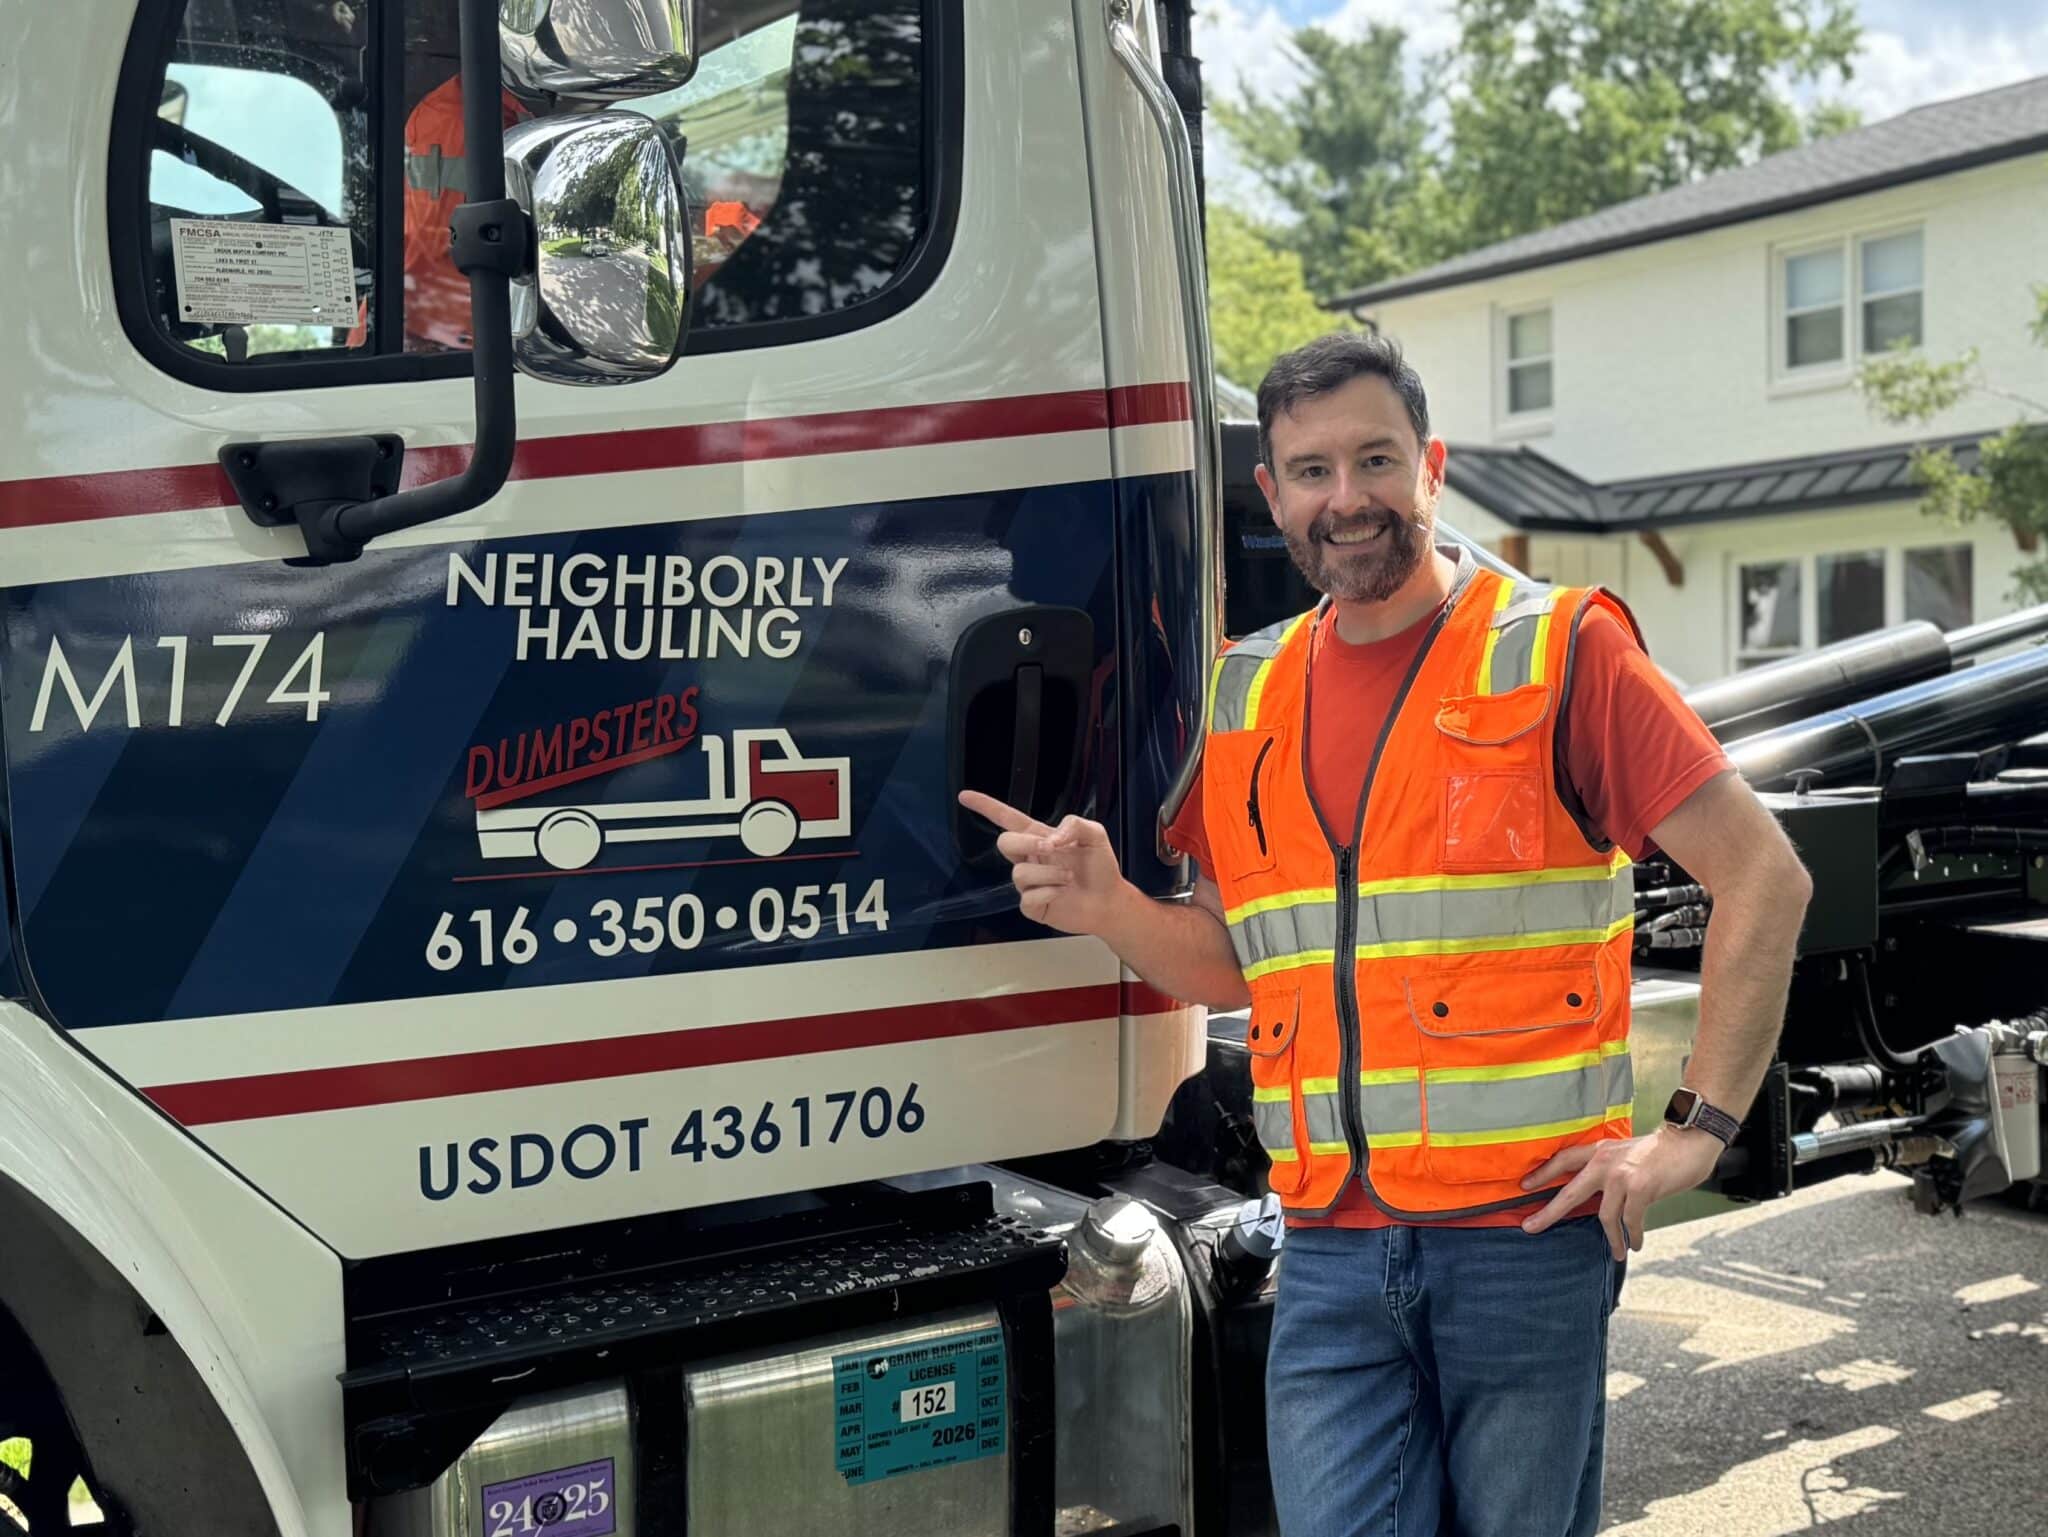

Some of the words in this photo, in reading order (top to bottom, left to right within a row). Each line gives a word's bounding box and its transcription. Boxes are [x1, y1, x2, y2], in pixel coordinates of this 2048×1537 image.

[179, 227, 221, 238] FMCSA
[446, 553, 849, 606] NEIGHBORLY
[516, 607, 802, 661] HAULING
[29, 631, 330, 733] M174
[465, 686, 699, 798] DUMPSTERS
[418, 1117, 649, 1201] USDOT
[671, 1082, 925, 1163] 4361706
[889, 1350, 929, 1367] GRAND
[932, 1340, 974, 1360] RAPIDS
[981, 1355, 999, 1366] AUG
[840, 1361, 859, 1373] JAN
[909, 1362, 957, 1382] LICENSE
[981, 1375, 999, 1387] SEP
[912, 1387, 946, 1417] 152
[981, 1396, 999, 1407] OCT
[840, 1402, 862, 1416] MAR
[981, 1416, 999, 1428] NOV
[841, 1424, 861, 1437] APR
[932, 1423, 976, 1448] 2026
[981, 1437, 999, 1449] DEC
[840, 1446, 862, 1458] MAY
